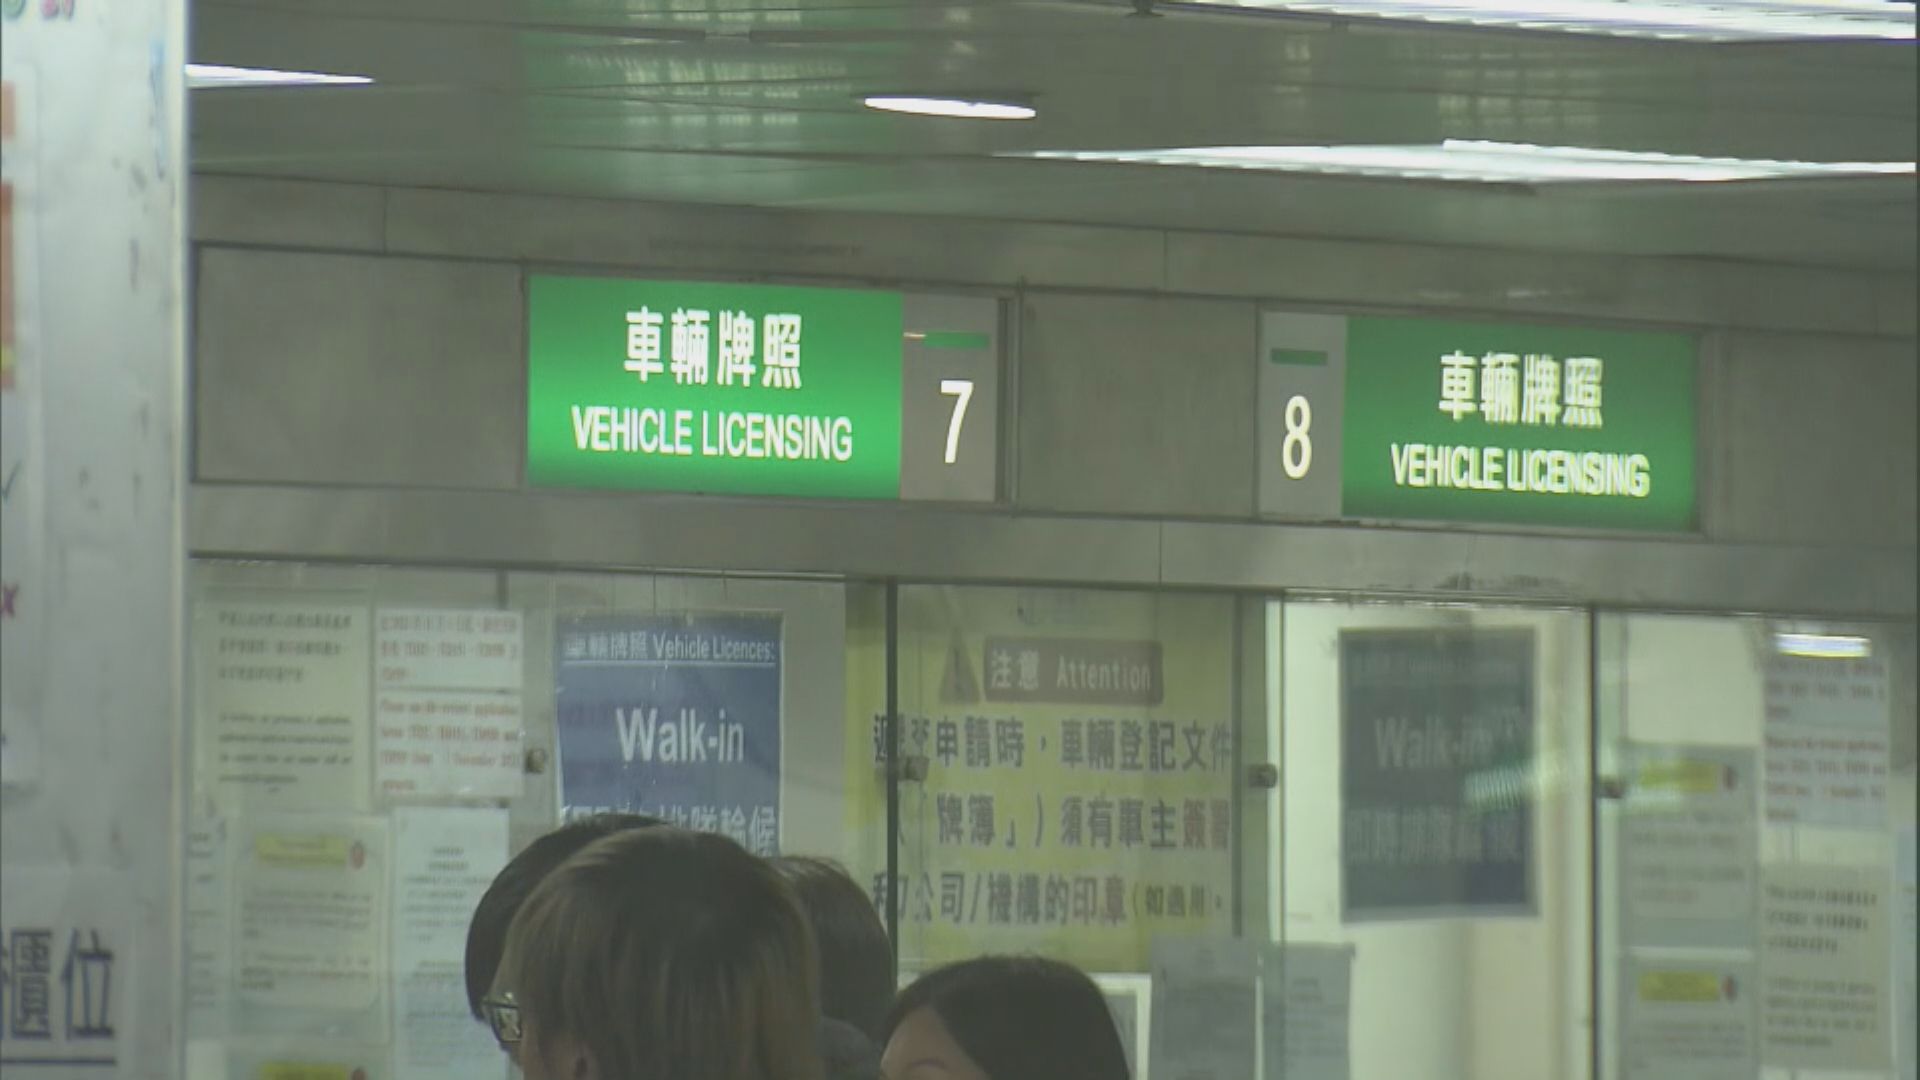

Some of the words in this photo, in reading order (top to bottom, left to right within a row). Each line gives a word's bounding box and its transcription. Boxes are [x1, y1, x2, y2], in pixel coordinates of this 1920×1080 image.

[624, 306, 803, 389] 車輛牌照
[1438, 350, 1604, 428] 車輛牌照
[571, 405, 693, 456] VEHICLE
[702, 411, 853, 462] LICENSING
[940, 380, 974, 463] 7
[1282, 395, 1312, 479] 8
[1390, 442, 1505, 491] VEHICLE
[1507, 448, 1651, 498] LICENSING
[652, 632, 710, 660] Vehicle
[990, 649, 1040, 690] 注意
[1056, 655, 1151, 692] Attention
[616, 708, 744, 763] Walk-in
